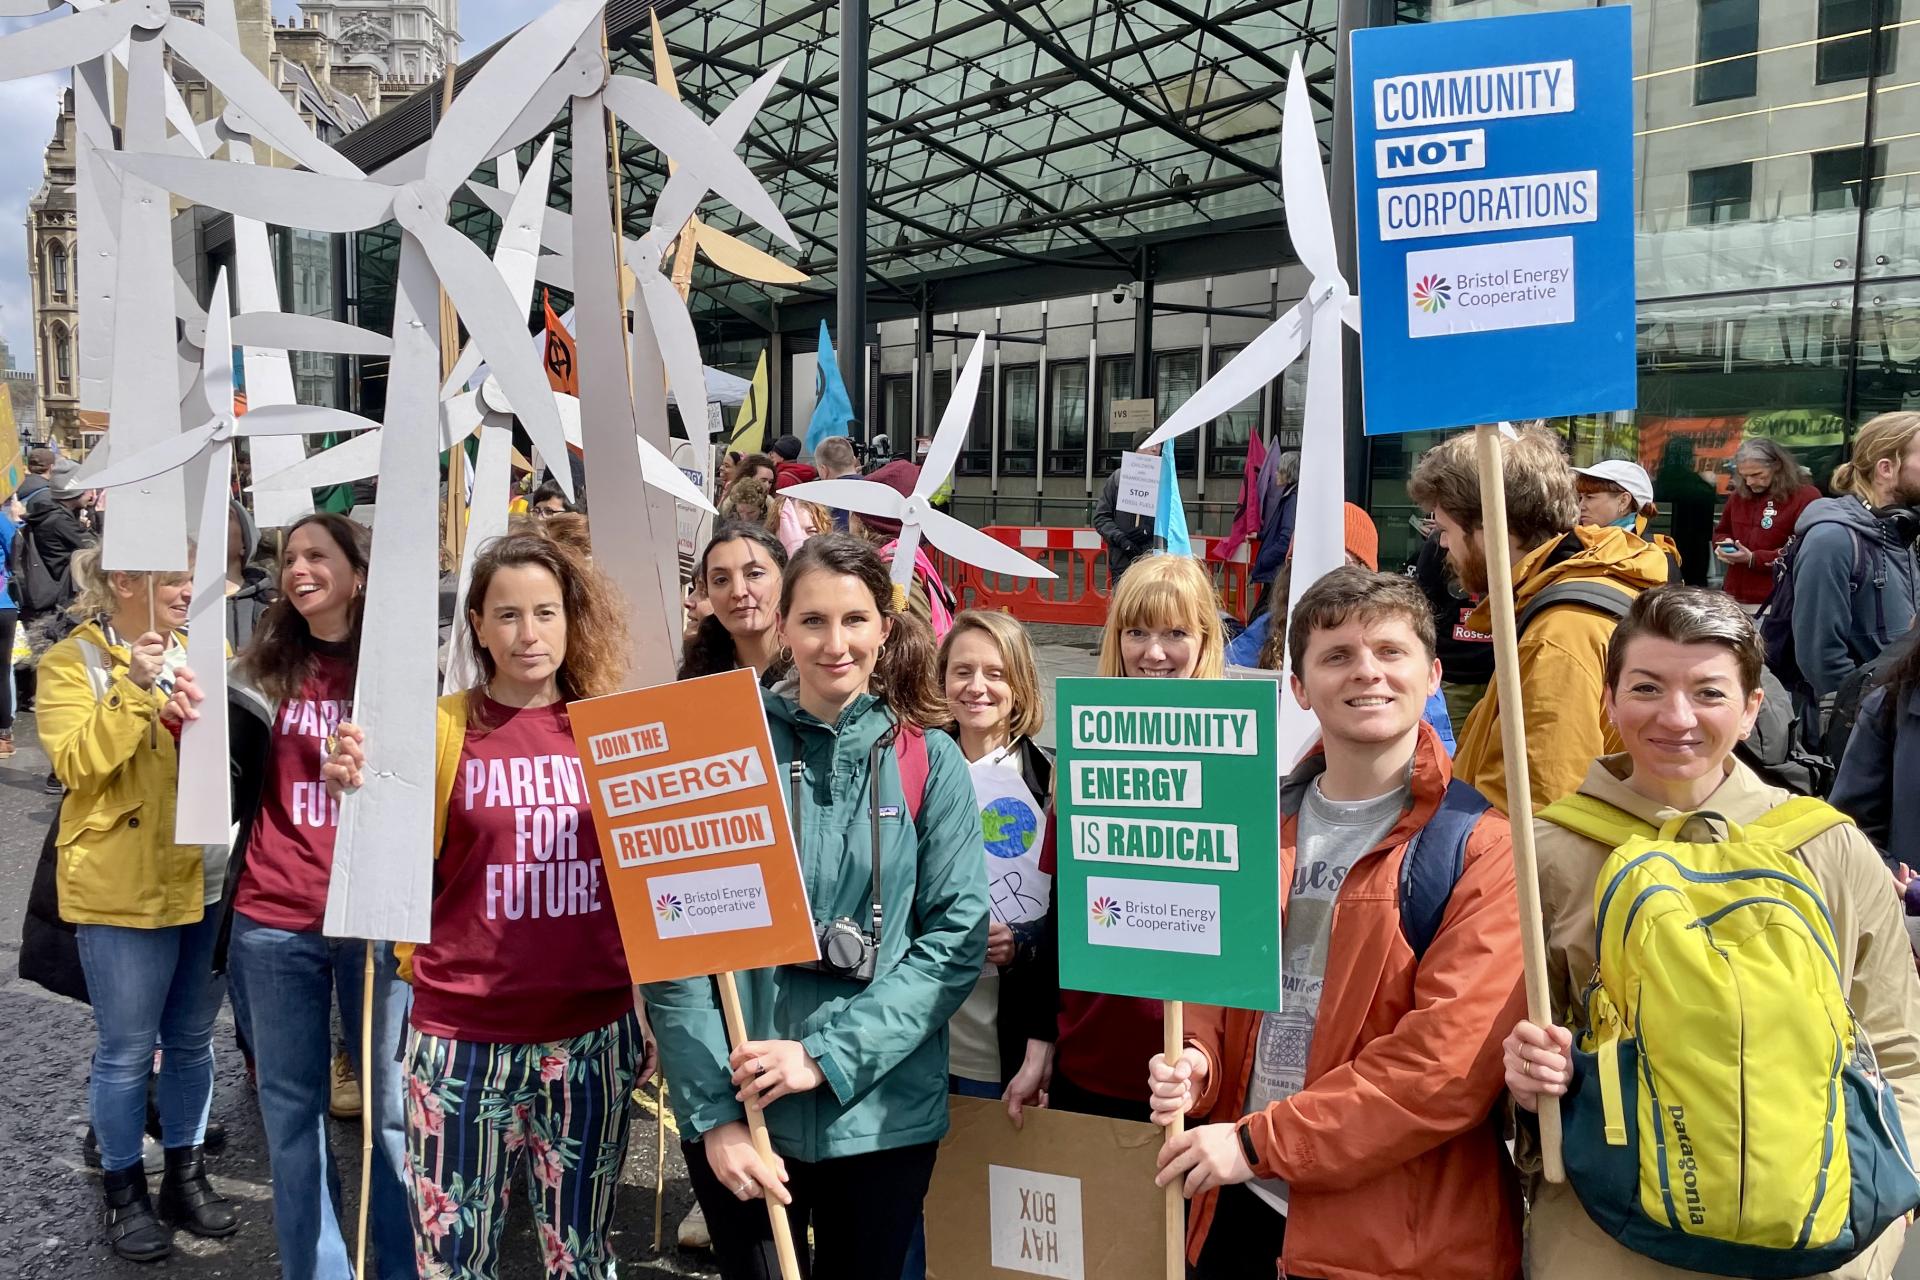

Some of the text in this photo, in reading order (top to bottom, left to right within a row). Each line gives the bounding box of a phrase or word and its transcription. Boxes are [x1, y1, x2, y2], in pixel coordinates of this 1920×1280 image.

[1382, 67, 1562, 122] COMMUNITY
[1386, 138, 1474, 169] NOT
[1387, 179, 1588, 230] CORPORATIONS
[1456, 266, 1570, 290] Bristol Energy
[1458, 285, 1556, 308] Cooperative
[1129, 488, 1150, 498] STOP
[595, 727, 664, 760] JOIN THE
[1078, 709, 1249, 748] COMMUNITY
[608, 755, 751, 809] ENERGY
[1080, 767, 1188, 801] ENERGY
[514, 805, 580, 862] FOR
[618, 812, 766, 861] REVOLUTION
[1081, 821, 1232, 864] IS RADICAL
[486, 857, 602, 921] FUTURE
[684, 886, 762, 905] Bristol Energy
[687, 899, 756, 917] Cooperative
[1125, 900, 1216, 922] Bristol Energy
[1126, 916, 1206, 933] Cooperative
[1667, 1105, 1706, 1226] patagonia
[1019, 1187, 1057, 1225] BOX
[1020, 1226, 1058, 1264] HAY
